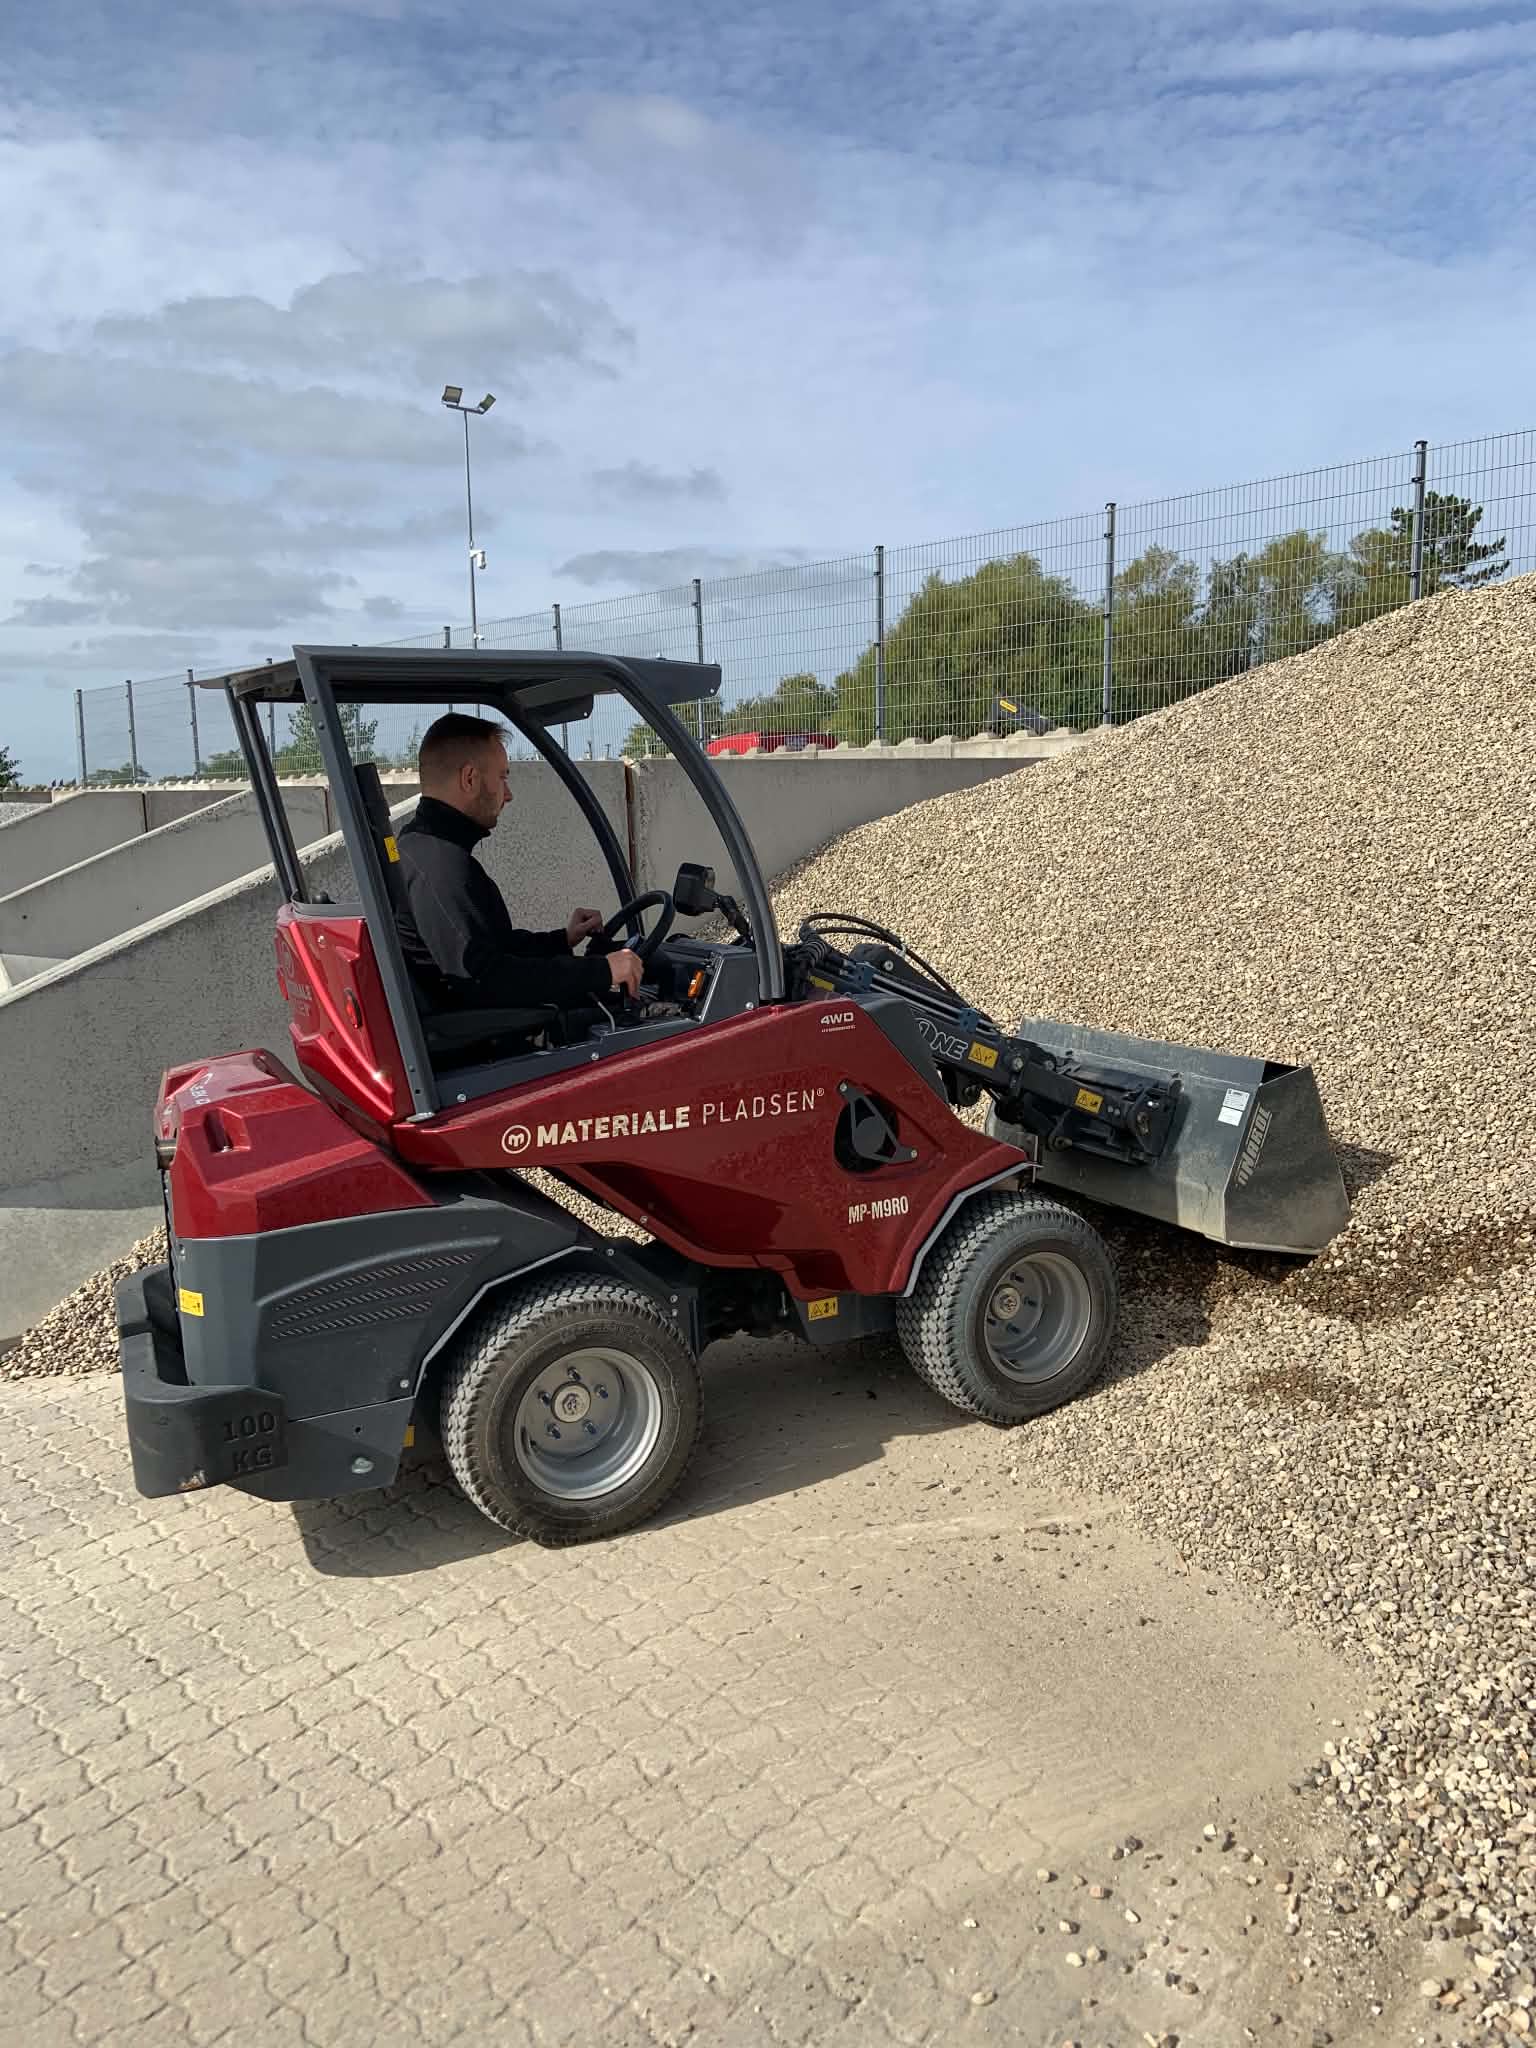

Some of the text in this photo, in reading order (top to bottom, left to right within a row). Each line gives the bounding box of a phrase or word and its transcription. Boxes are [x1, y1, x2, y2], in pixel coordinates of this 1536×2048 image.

[820, 1012, 854, 1025] 4WD
[536, 1106, 690, 1148] MATERIALE
[223, 1411, 277, 1444] 100
[232, 1446, 273, 1472] KG
